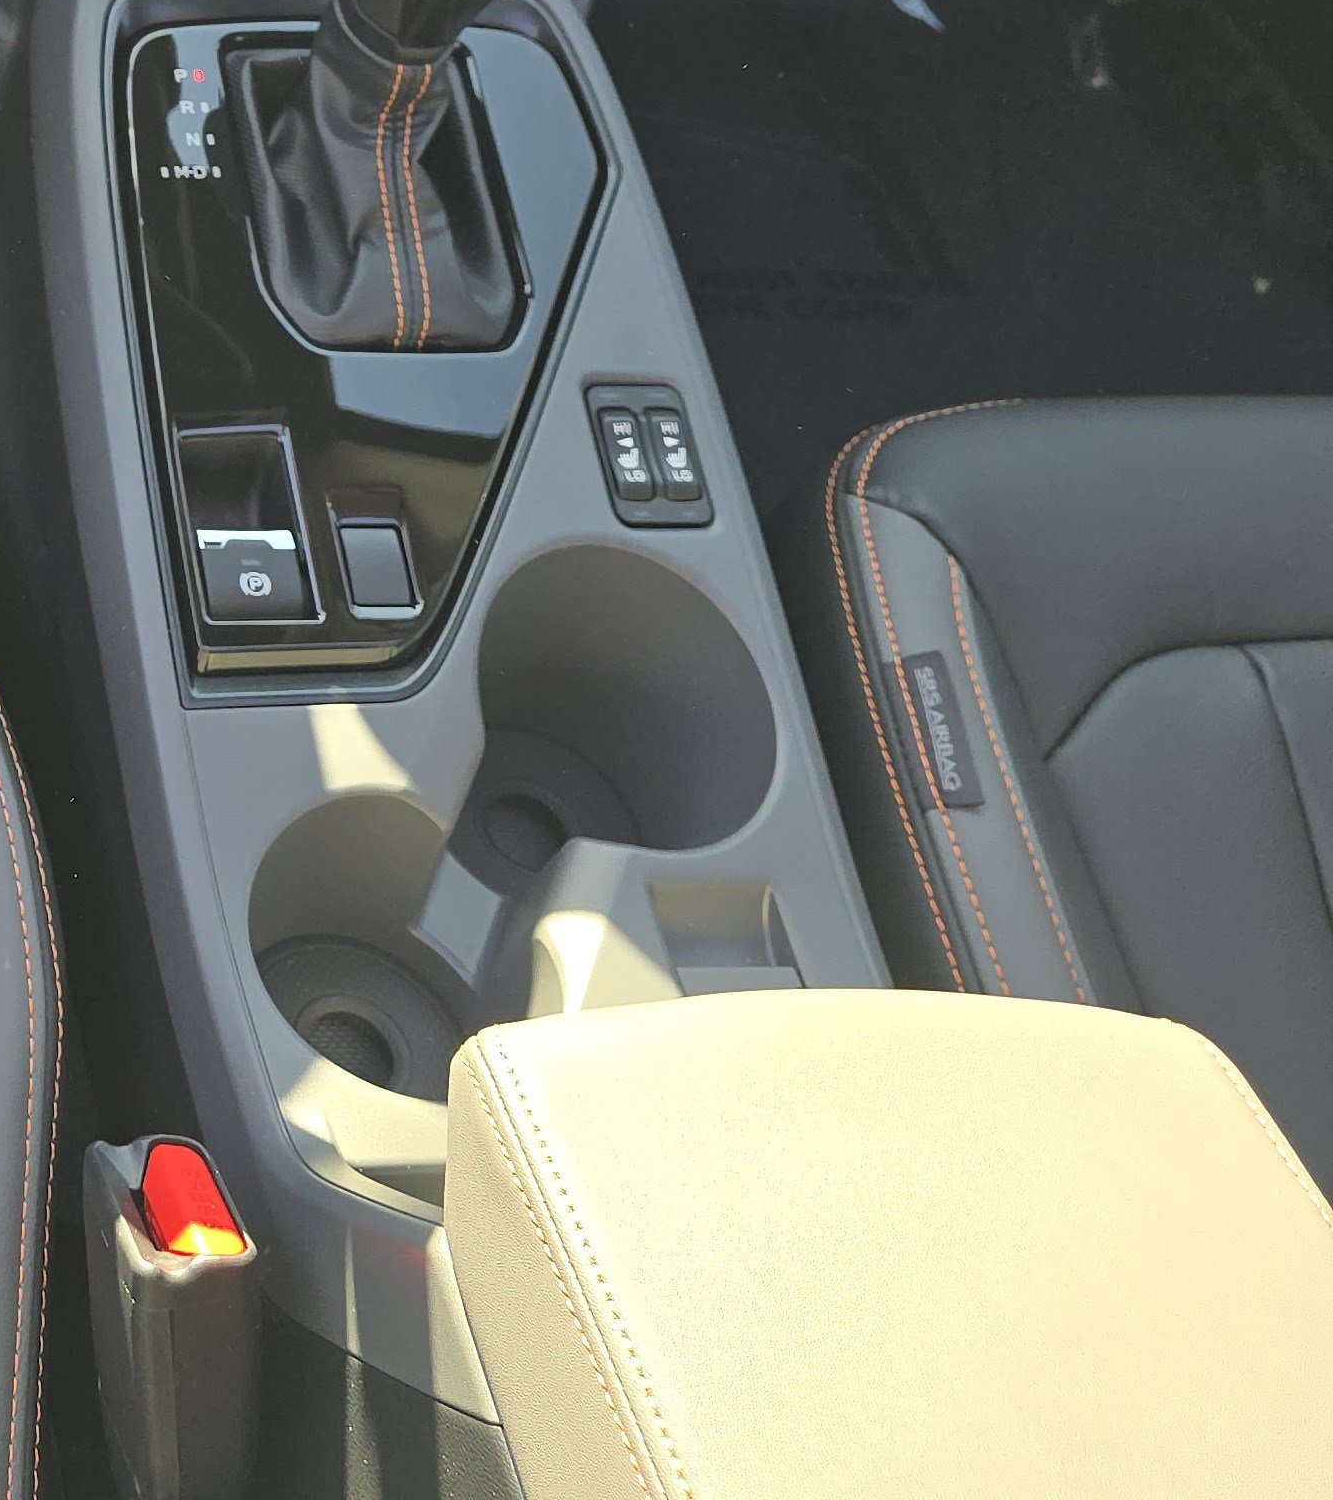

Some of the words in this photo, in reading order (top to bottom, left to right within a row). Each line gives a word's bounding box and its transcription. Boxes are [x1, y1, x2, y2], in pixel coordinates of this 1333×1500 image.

[174, 69, 187, 83] P
[180, 100, 195, 114] R
[185, 132, 202, 146] N
